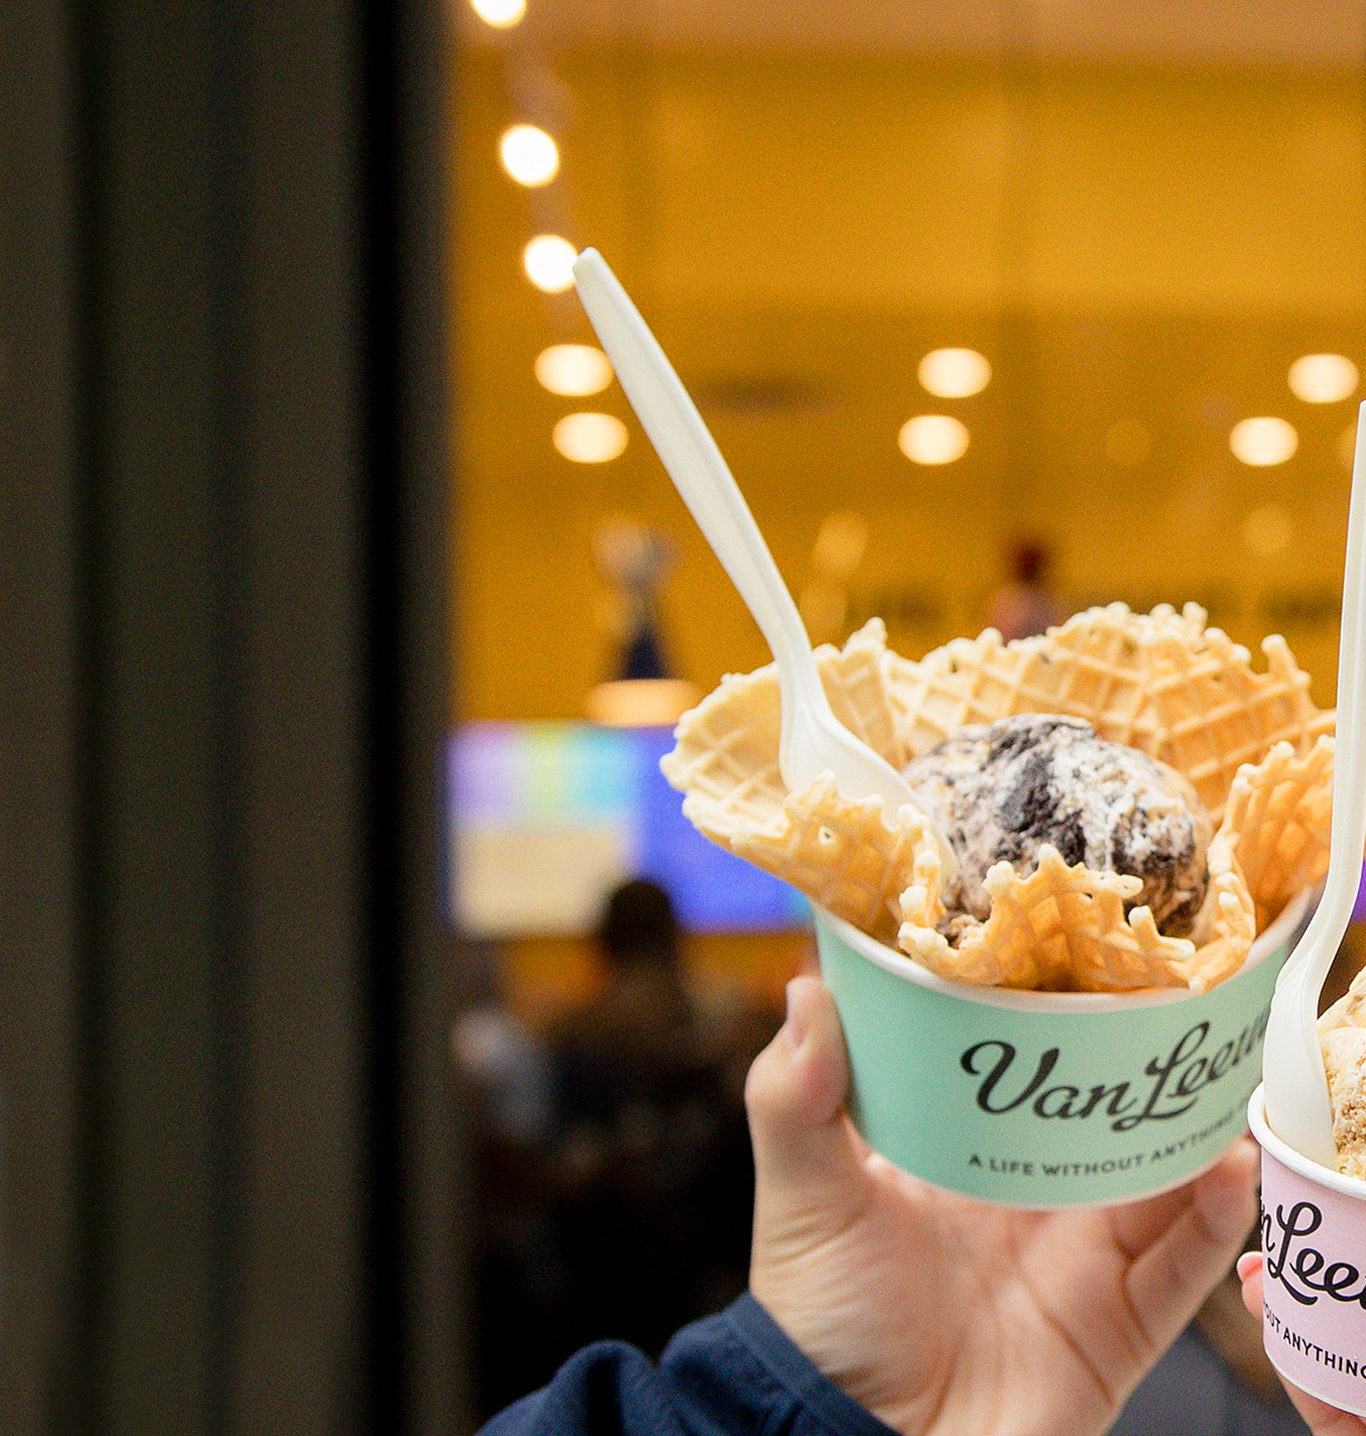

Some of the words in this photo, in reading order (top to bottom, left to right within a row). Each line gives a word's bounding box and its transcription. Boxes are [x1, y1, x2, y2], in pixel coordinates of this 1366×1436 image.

[960, 1039, 1137, 1121] Van
[968, 1154, 982, 1168] A
[989, 1159, 1033, 1176] LIFE
[1041, 1153, 1145, 1177] WITHOUT
